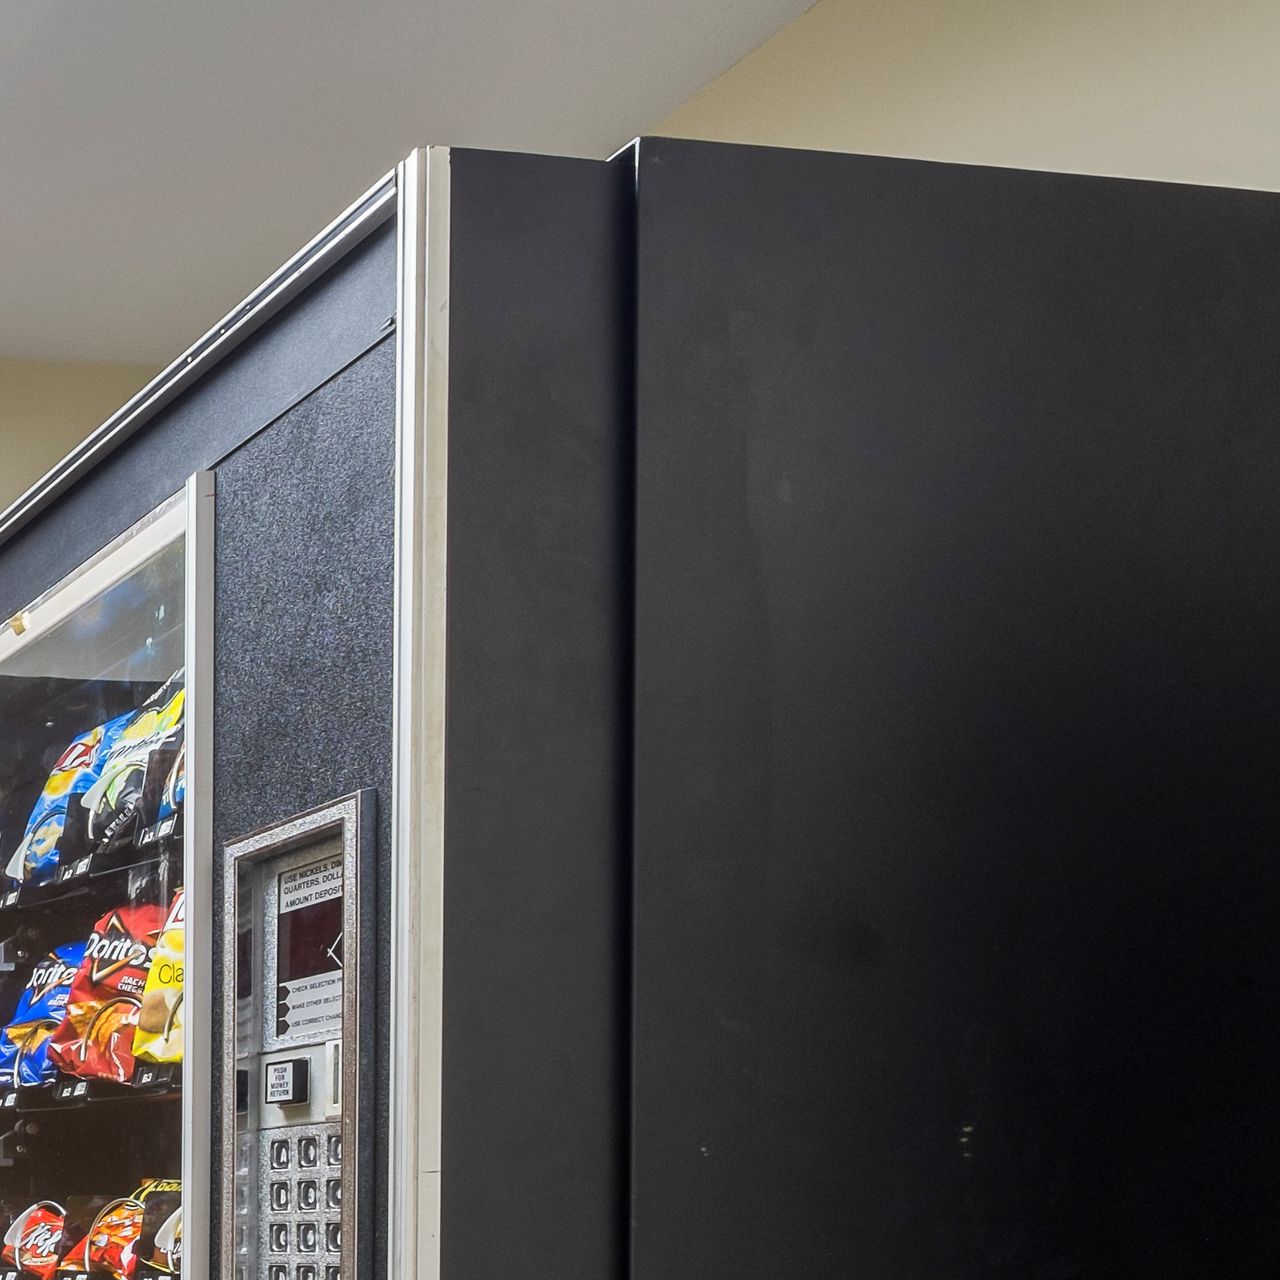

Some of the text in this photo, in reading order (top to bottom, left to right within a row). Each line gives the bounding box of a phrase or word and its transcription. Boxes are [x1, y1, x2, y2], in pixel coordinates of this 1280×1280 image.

[283, 873, 298, 885] USE
[285, 893, 313, 909] AMOUNT
[83, 933, 157, 969] Doritos
[26, 963, 78, 989] orito
[158, 963, 184, 984] Cla
[121, 975, 145, 987] NACH
[274, 1066, 287, 1074] PUSH
[141, 1073, 152, 1083] B3
[271, 1081, 289, 1089] MONEY
[271, 1089, 289, 1097] RETURN
[280, 1147, 287, 1163] A
